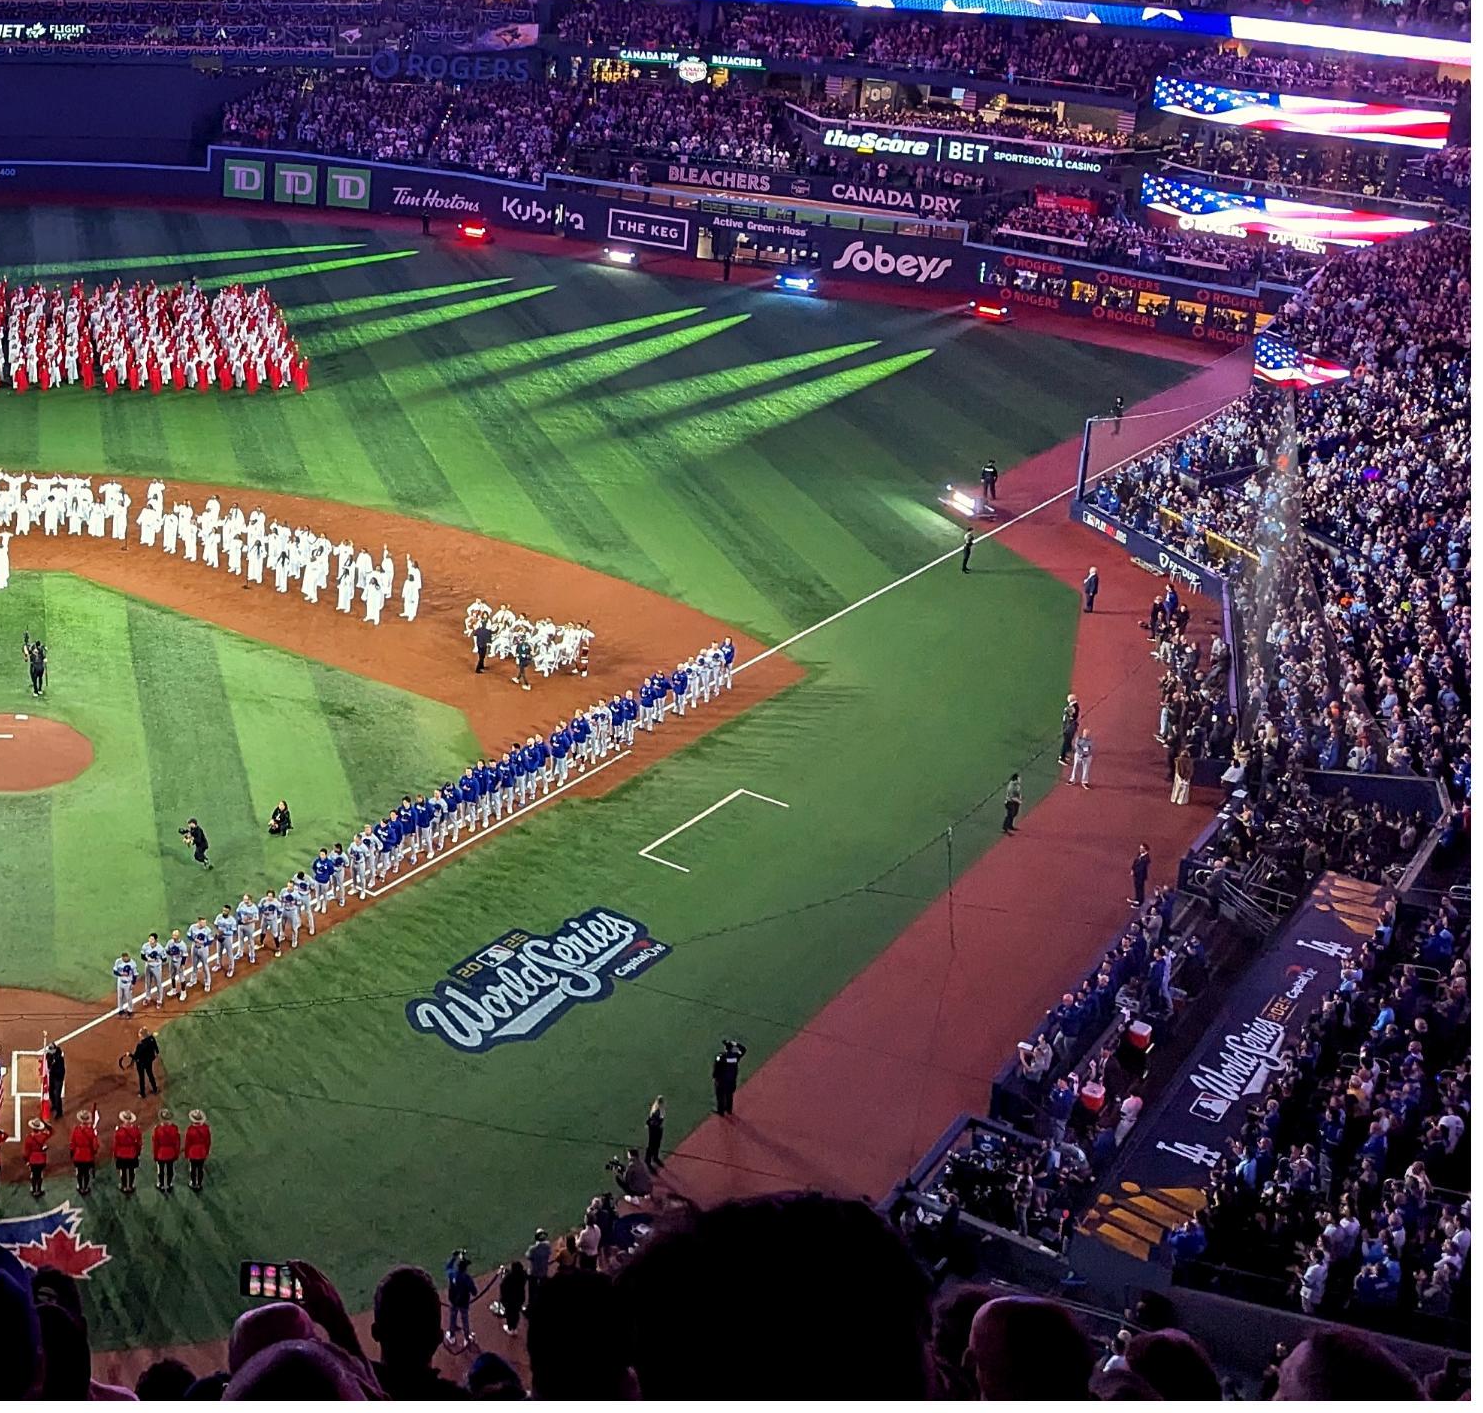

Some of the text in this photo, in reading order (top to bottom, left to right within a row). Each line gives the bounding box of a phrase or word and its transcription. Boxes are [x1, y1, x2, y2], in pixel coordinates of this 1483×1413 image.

[49, 24, 86, 34] FLIGHT
[620, 50, 680, 62] CANADA DRY
[712, 55, 763, 68] BLEACHERS
[406, 53, 530, 83] ROGERS
[823, 128, 990, 164] theScore BET
[993, 150, 1102, 174] SPORTSBOOK & CASINO
[229, 165, 261, 191] TD
[279, 169, 312, 196] TD
[331, 173, 366, 200] TD
[668, 164, 771, 192] BLEACHERS
[392, 186, 420, 207] Tim
[421, 188, 481, 214] Hortons
[831, 183, 915, 209] CANADA
[919, 193, 962, 214] DRY
[617, 219, 679, 240] THE KEG
[712, 216, 745, 230] Active
[832, 240, 953, 283] Sobeys
[1016, 256, 1064, 275] ROGERS
[1110, 274, 1161, 292] ROGERS
[1013, 291, 1060, 310] ROGERS
[1211, 292, 1265, 311] ROGERS
[1106, 309, 1156, 328] ROGERS
[502, 932, 530, 949] 25
[415, 911, 638, 1047] World Series
[456, 961, 484, 979] 20
[1189, 1015, 1286, 1103] World Series
